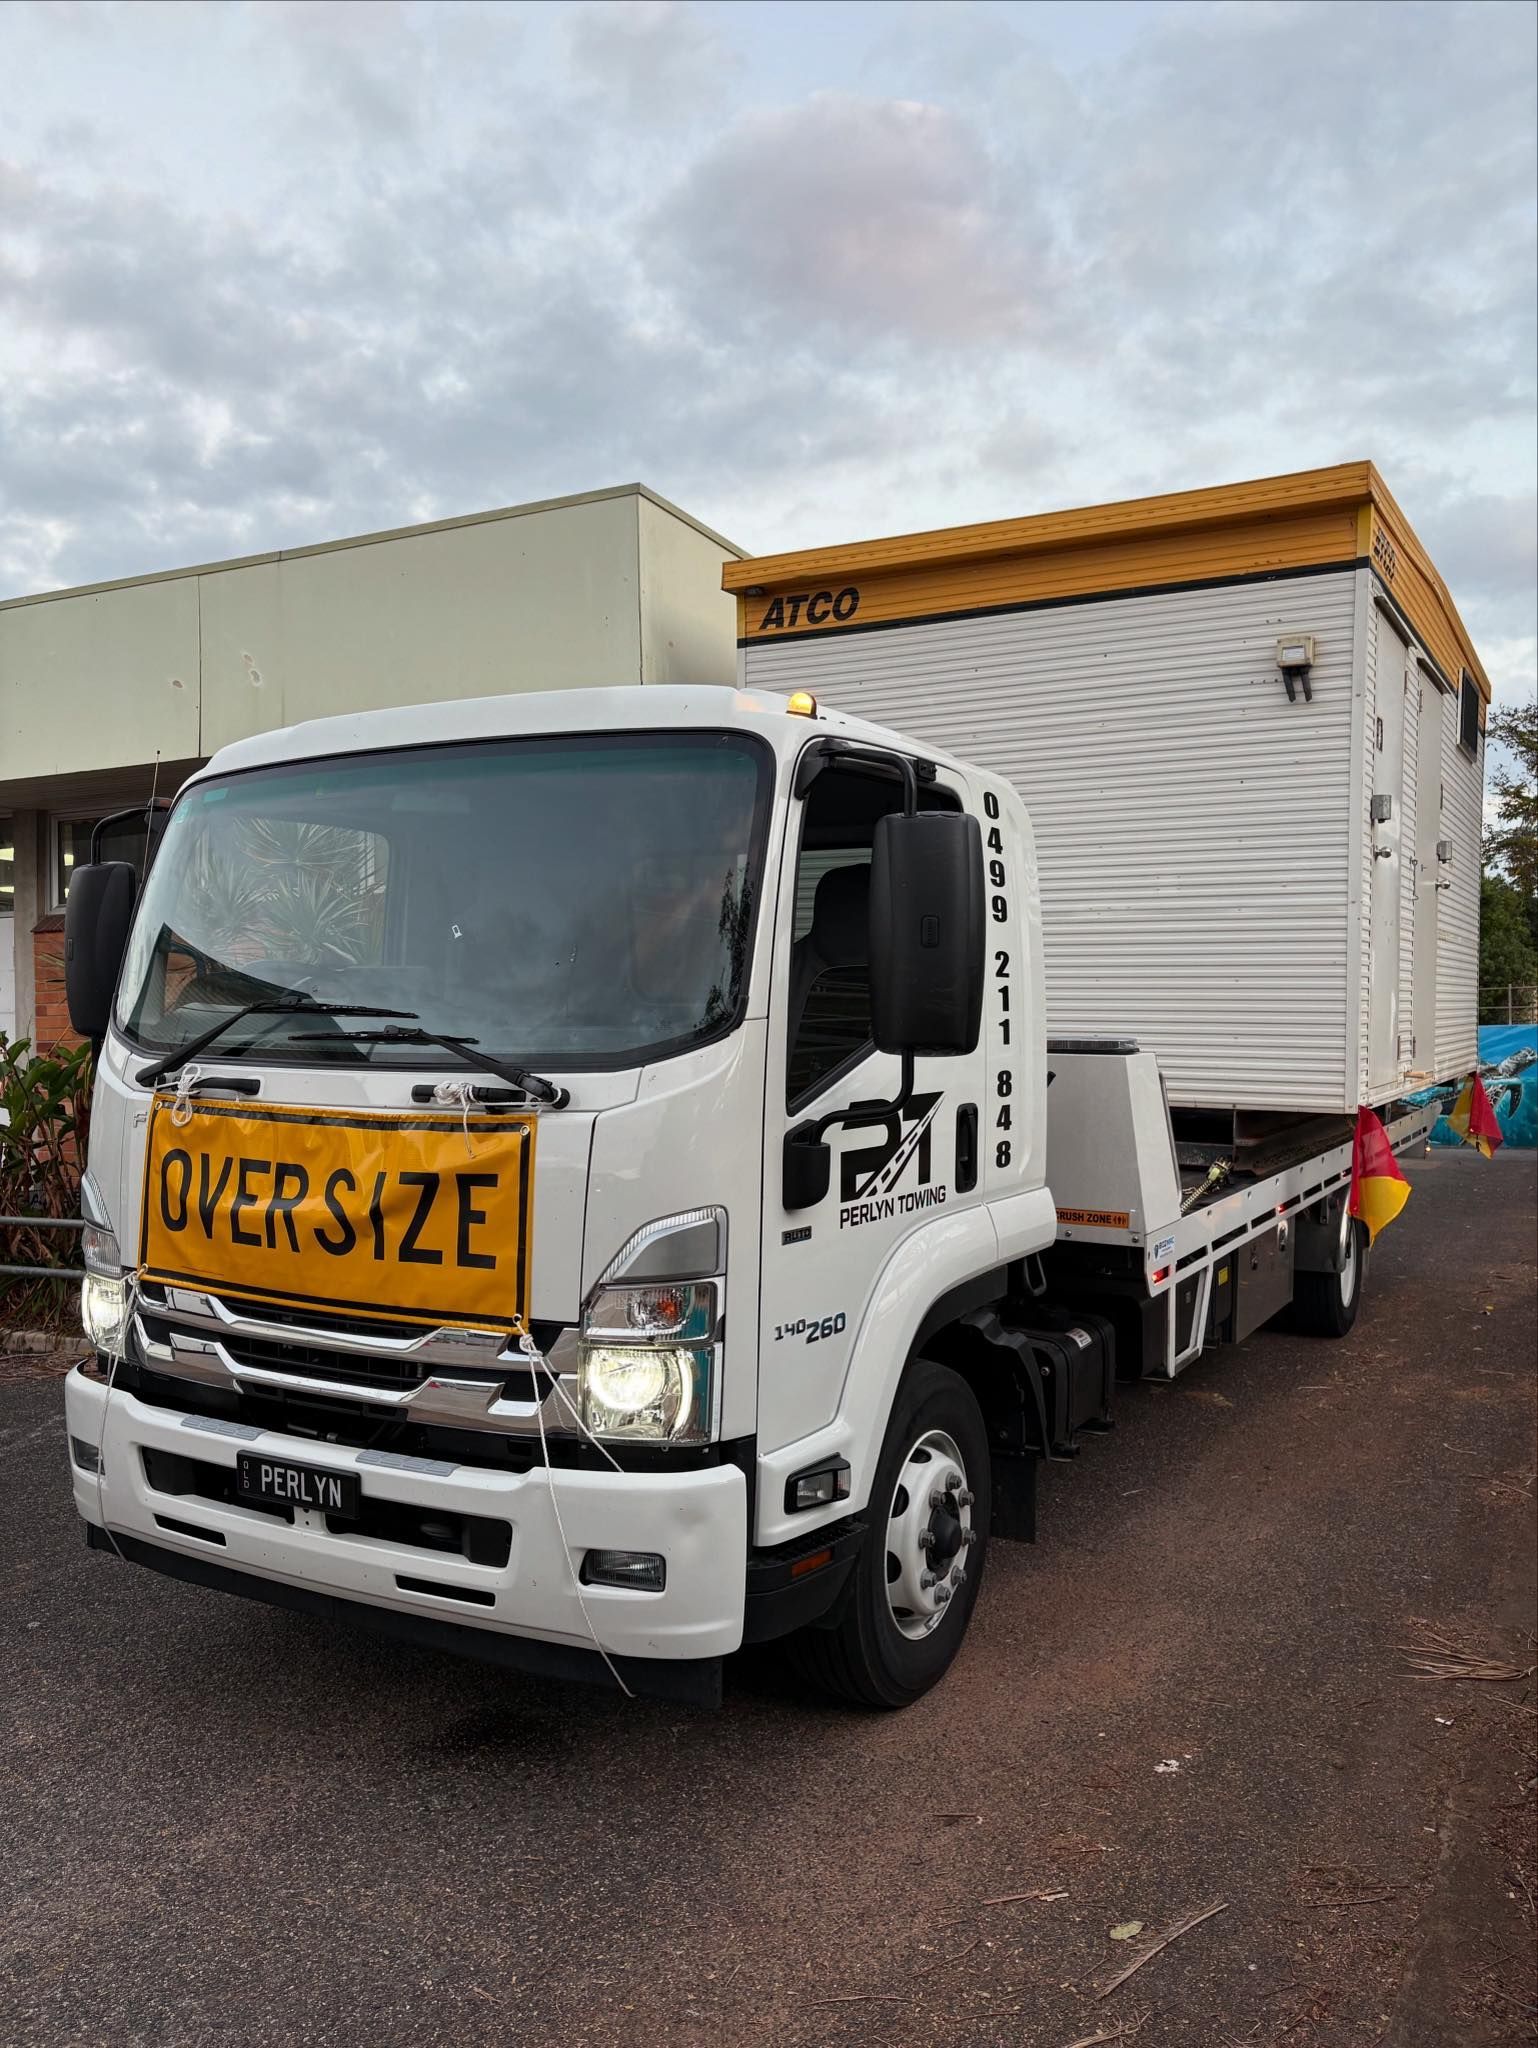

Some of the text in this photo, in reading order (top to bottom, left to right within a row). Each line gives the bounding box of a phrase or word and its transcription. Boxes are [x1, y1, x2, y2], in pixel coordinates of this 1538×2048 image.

[759, 587, 860, 630] ATCO
[983, 791, 1012, 1168] 0499 211 848
[160, 1148, 499, 1270] OVERSIZE
[840, 1185, 946, 1229] PERLYN TOWING
[1087, 1213, 1111, 1224] ZONE
[783, 1227, 811, 1243] AUTO
[774, 1312, 846, 1344] 140 260
[261, 1464, 342, 1508] PERLYN
